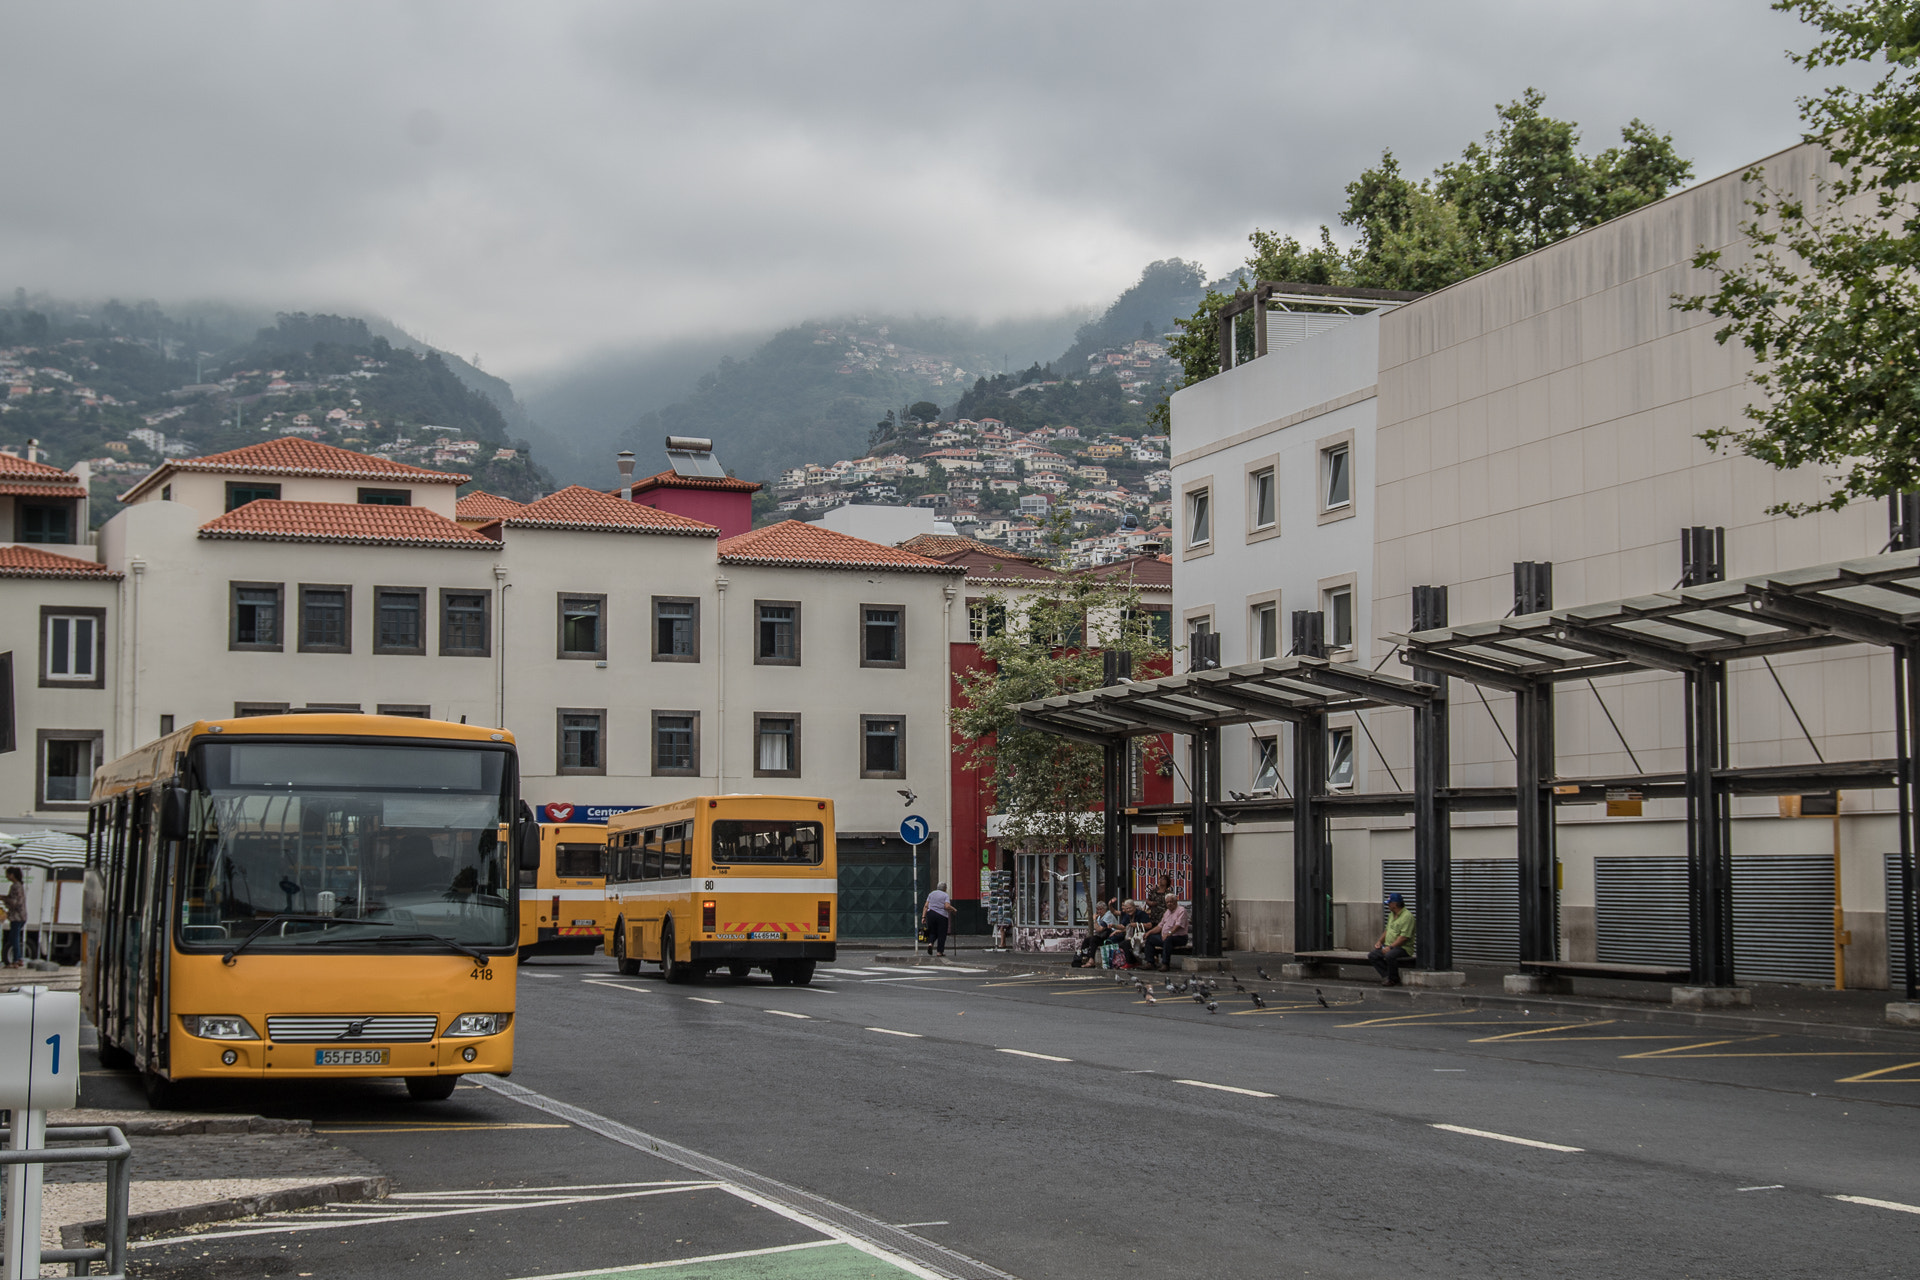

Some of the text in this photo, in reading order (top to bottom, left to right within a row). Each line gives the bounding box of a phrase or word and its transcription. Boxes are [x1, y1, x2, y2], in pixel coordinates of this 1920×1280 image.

[705, 880, 714, 891] 80
[470, 968, 493, 981] 418
[45, 1033, 61, 1075] 1
